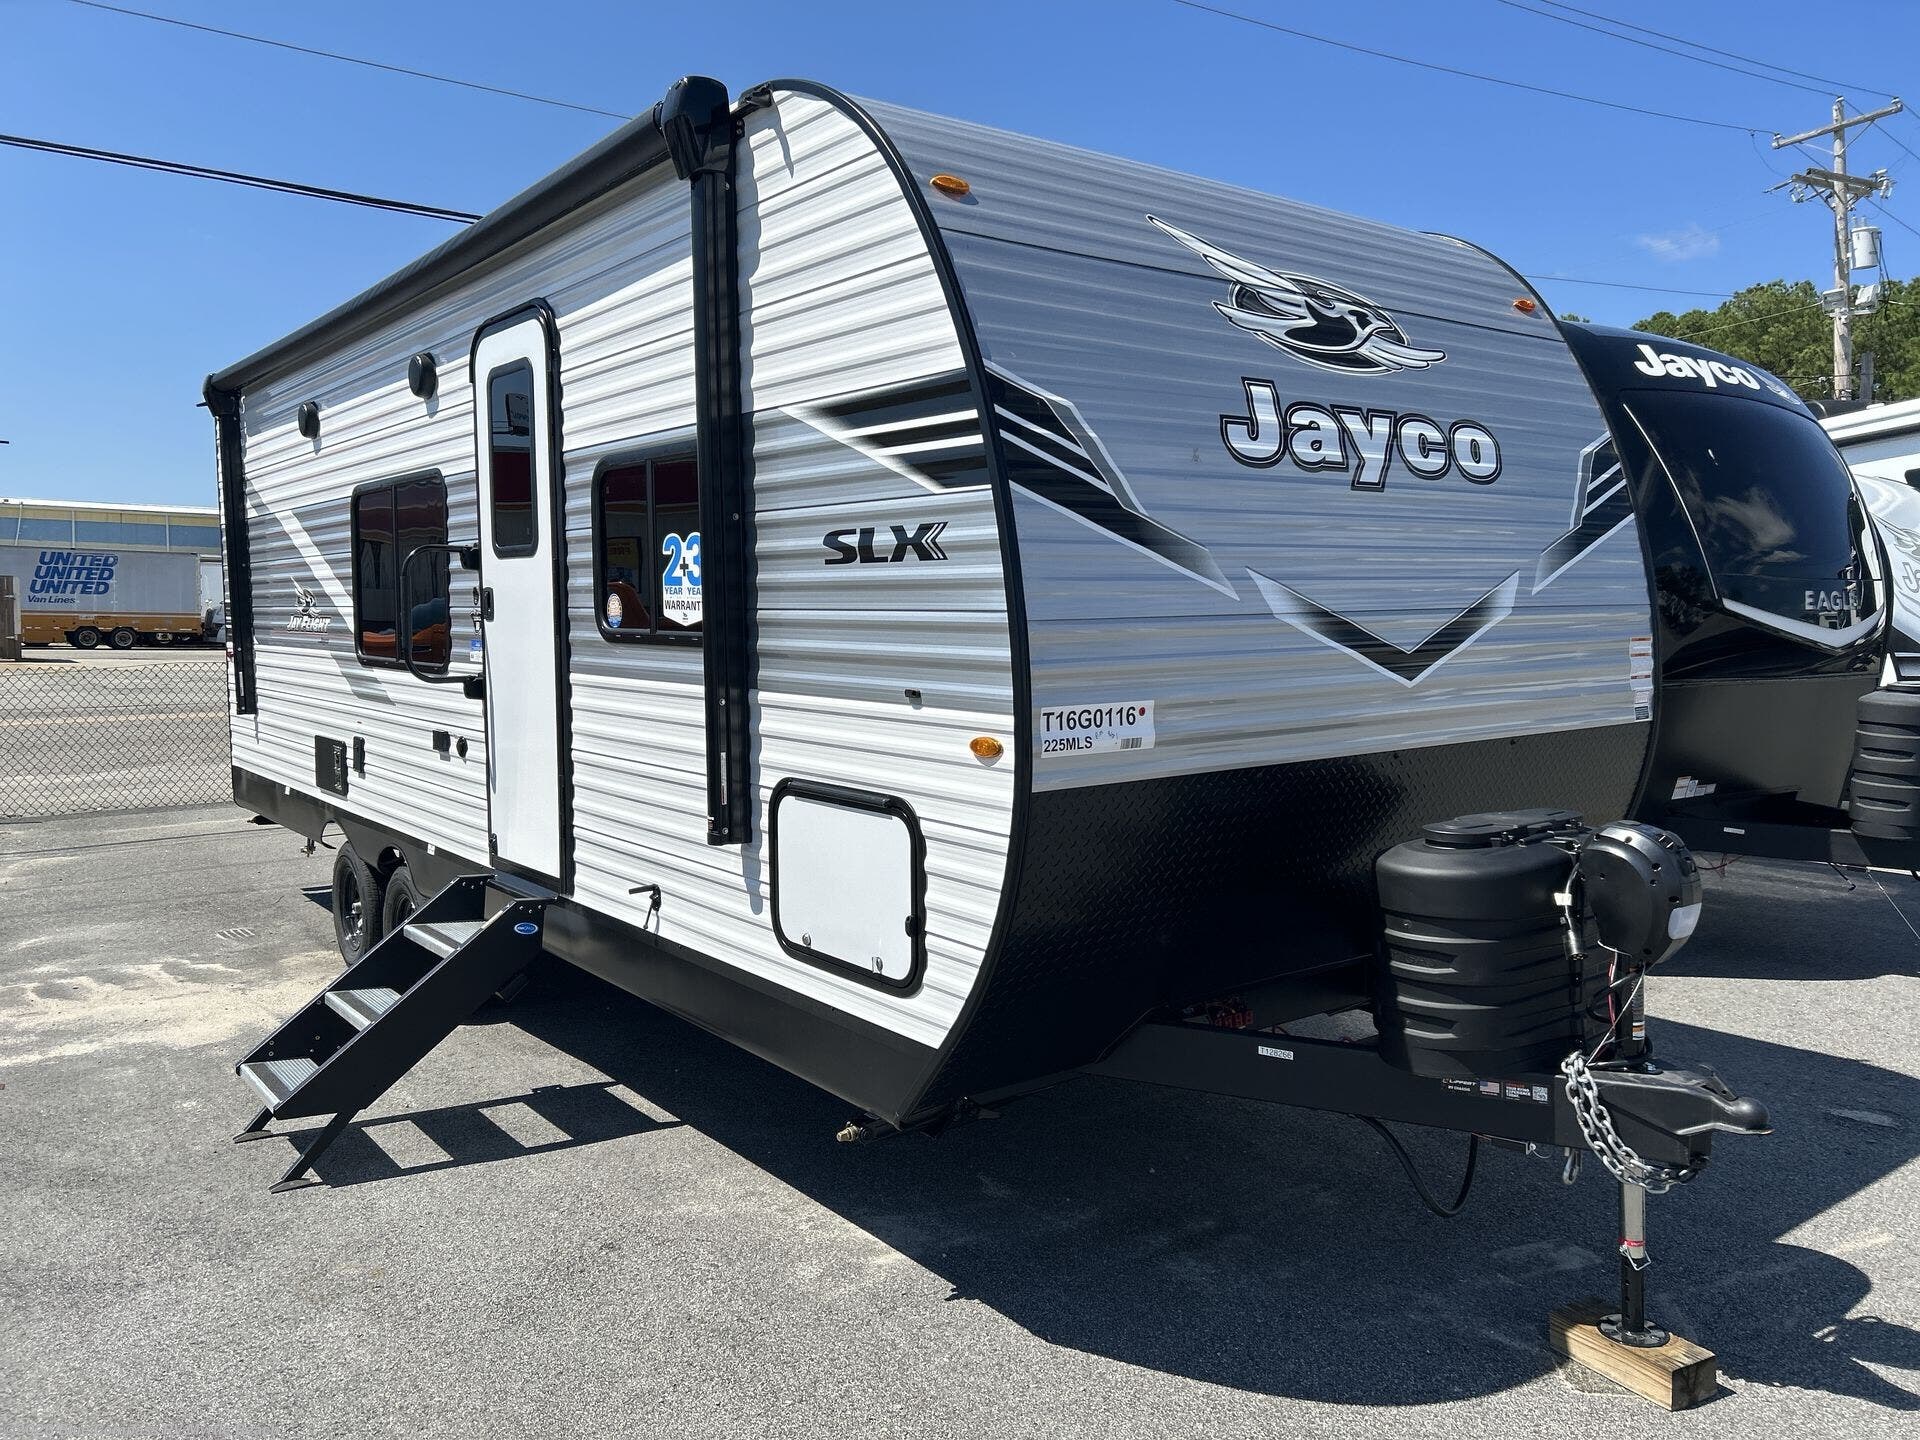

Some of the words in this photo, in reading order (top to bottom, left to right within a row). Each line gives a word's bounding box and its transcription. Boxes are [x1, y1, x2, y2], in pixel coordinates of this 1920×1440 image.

[1634, 344, 1761, 391] Jayco
[1219, 376, 1503, 492] Jayco
[823, 522, 949, 565] SLX
[39, 551, 119, 567] UNITED
[35, 566, 114, 581] UNITED
[30, 580, 110, 595] UNITED
[664, 587, 683, 596] YEAR
[687, 587, 702, 596] YEA
[27, 595, 47, 604] Van
[48, 595, 76, 604] Lines
[664, 600, 702, 612] WARRANT
[1042, 706, 1136, 732] T16G0116
[1044, 735, 1093, 753] 225MLS
